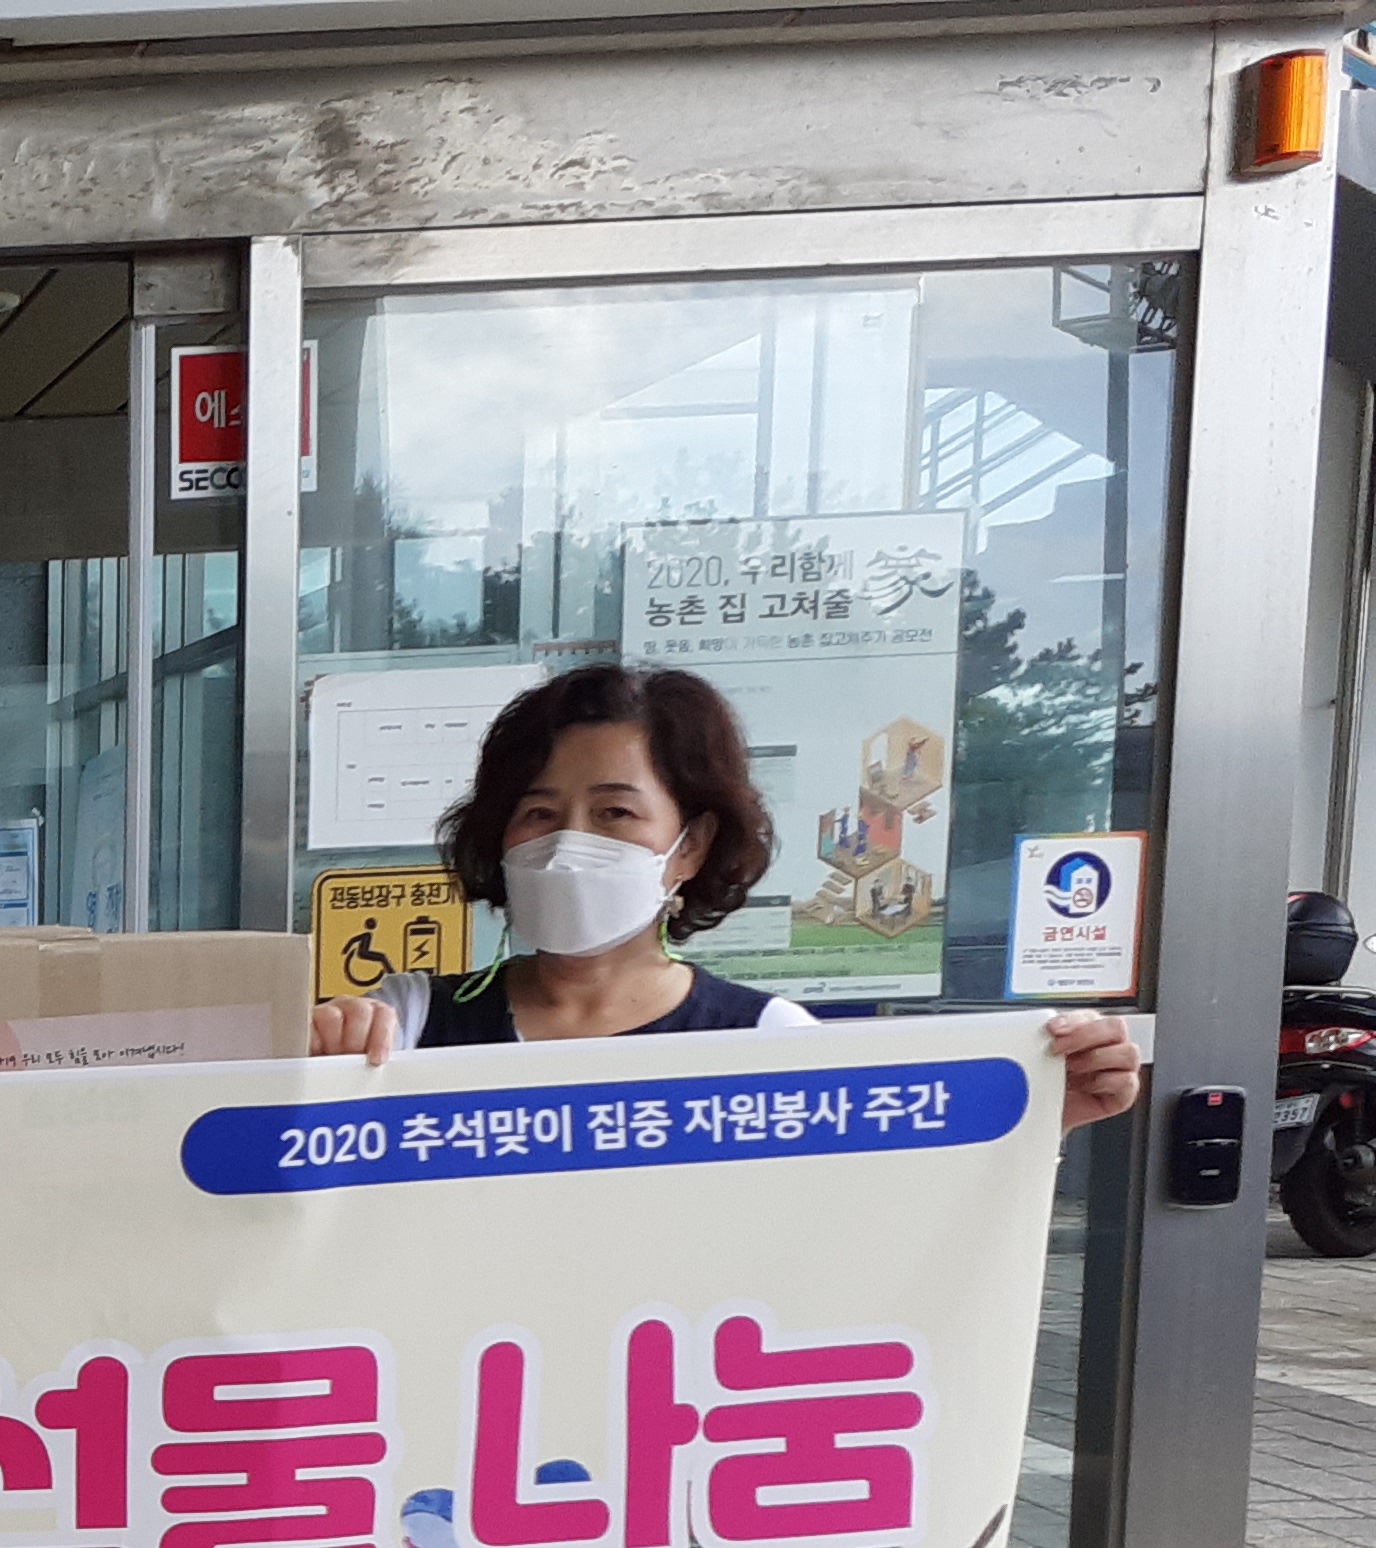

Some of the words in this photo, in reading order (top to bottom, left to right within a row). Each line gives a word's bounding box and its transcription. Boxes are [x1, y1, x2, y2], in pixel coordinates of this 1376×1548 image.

[740, 549, 854, 584] 우리함께
[645, 594, 707, 627] 농촌
[718, 592, 748, 624] 집
[758, 588, 853, 620] 고쳐줄
[330, 884, 406, 910] 전동보장구
[1042, 924, 1108, 942] 금연시설
[21, 1053, 41, 1066] 우리
[279, 1120, 387, 1170] 2020
[399, 1103, 574, 1164] 추석맞이
[586, 1097, 675, 1152] 집중
[684, 1085, 853, 1146] 자원봉사
[862, 1080, 950, 1131] 주간
